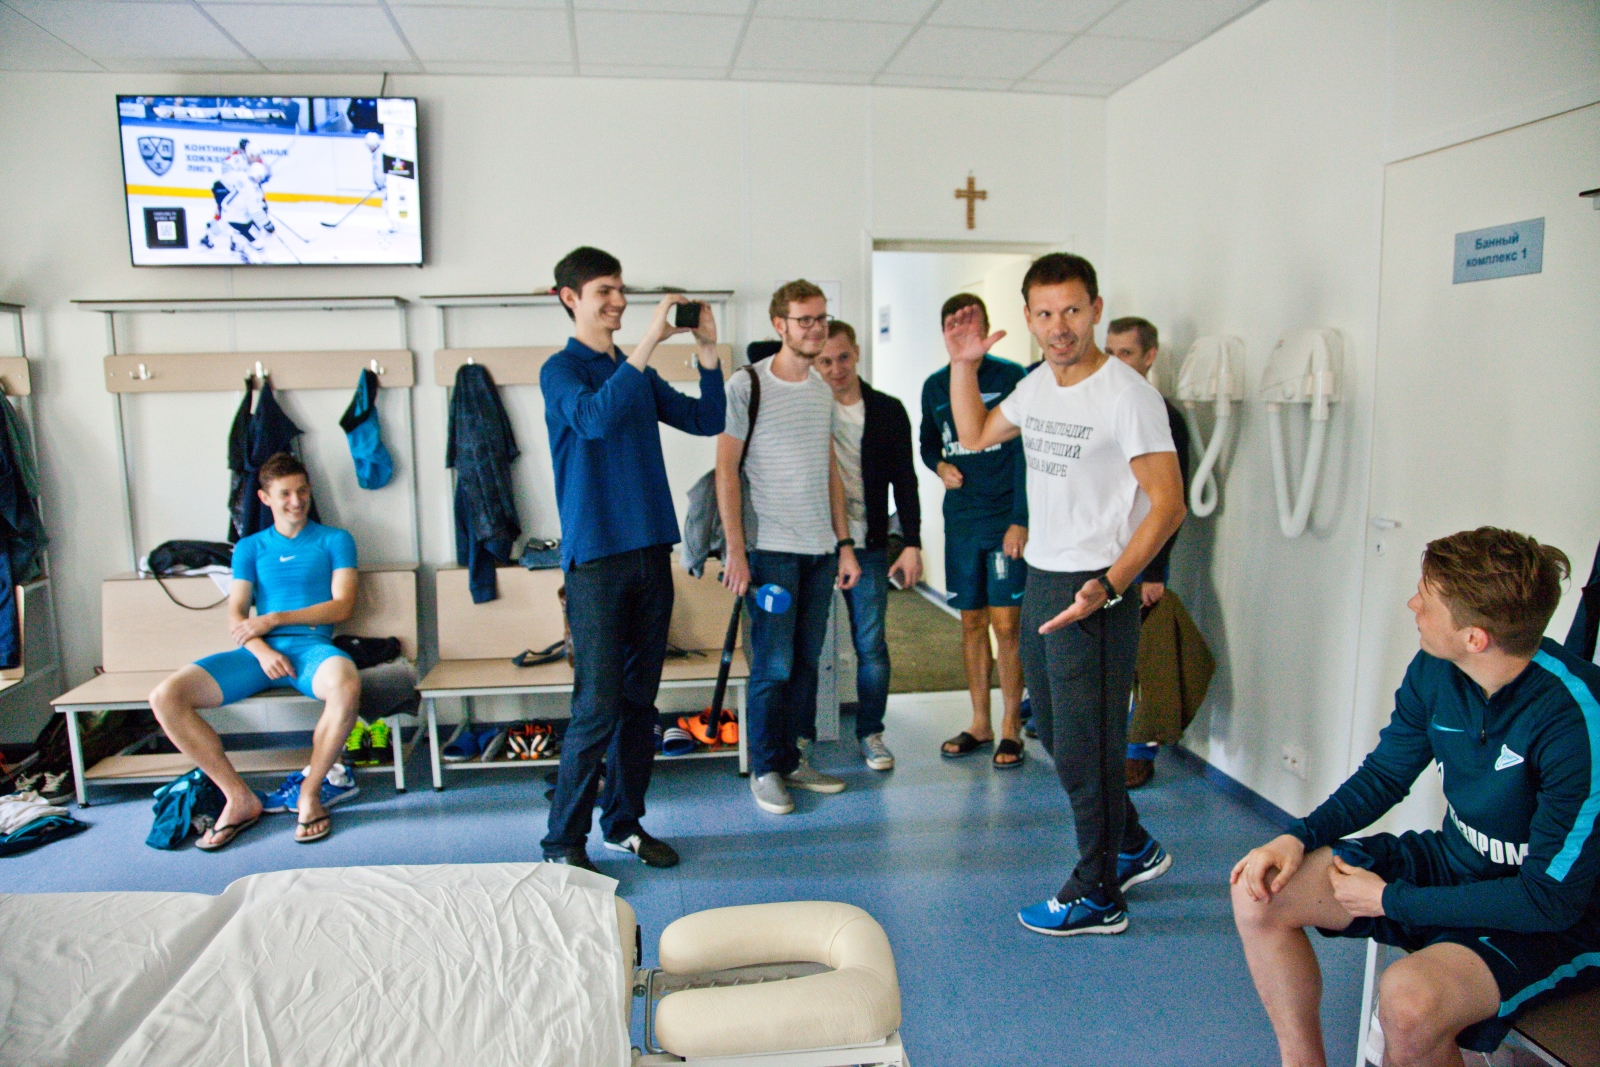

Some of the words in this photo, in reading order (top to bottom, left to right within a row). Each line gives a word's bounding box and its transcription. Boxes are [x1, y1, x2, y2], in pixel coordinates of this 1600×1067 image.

[1475, 232, 1519, 250] Банный
[1466, 252, 1518, 267] комплекс
[1521, 248, 1527, 259] 1
[1045, 421, 1093, 440] ВЫГЛЯДИТ
[1043, 440, 1081, 459] ЛУЧШИЙ
[1046, 461, 1068, 477] МИРЕ
